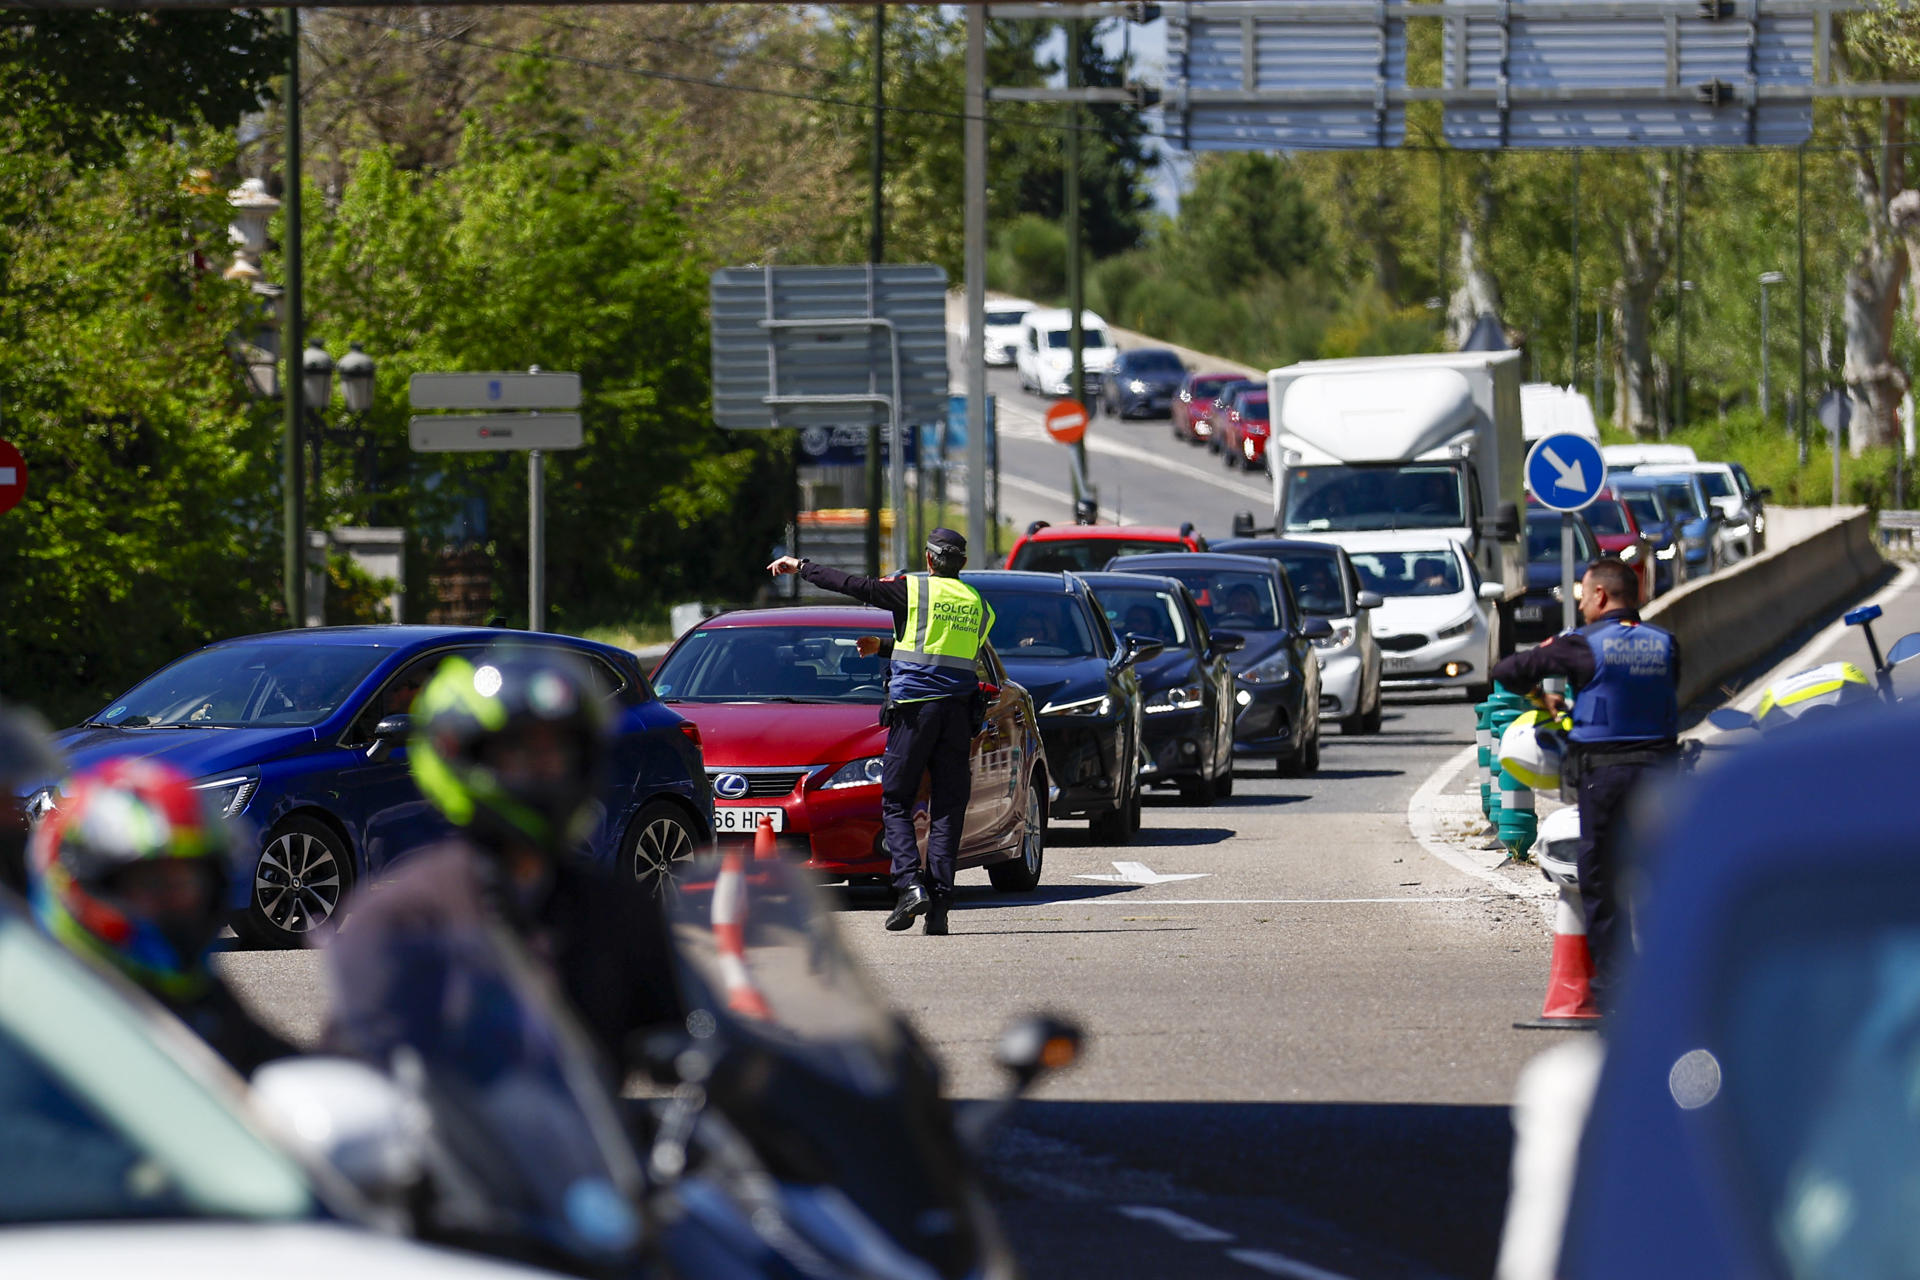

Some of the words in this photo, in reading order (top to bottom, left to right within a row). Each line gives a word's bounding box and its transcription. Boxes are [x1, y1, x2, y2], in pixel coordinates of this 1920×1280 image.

[933, 602, 979, 616] POLICÍA
[933, 614, 978, 625] MUNICIPAL
[951, 624, 978, 633] Madrid
[1604, 653, 1665, 665] MUNICIPAL
[1629, 665, 1668, 676] Madrid
